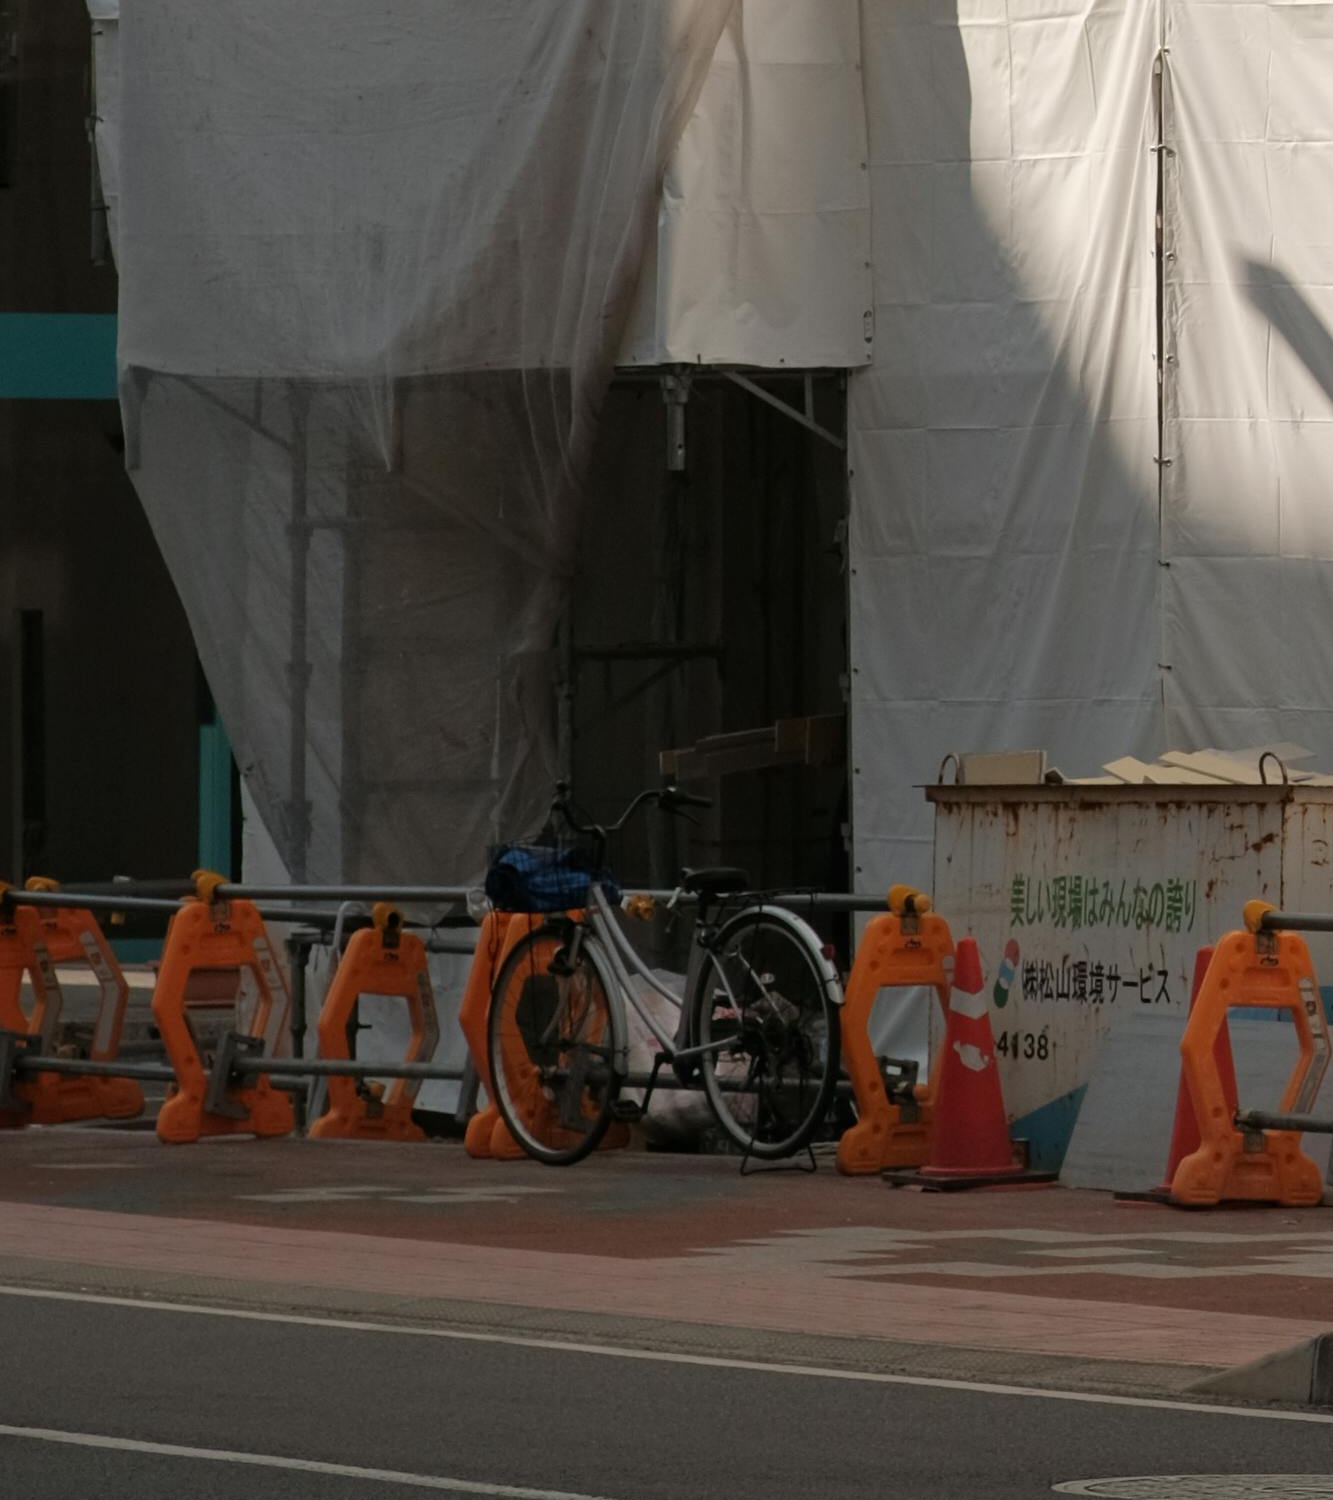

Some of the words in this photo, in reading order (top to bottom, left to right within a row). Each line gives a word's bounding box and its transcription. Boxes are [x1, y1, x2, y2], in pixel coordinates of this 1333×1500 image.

[1011, 873, 1197, 933] 美しい現場はみんなの誇り
